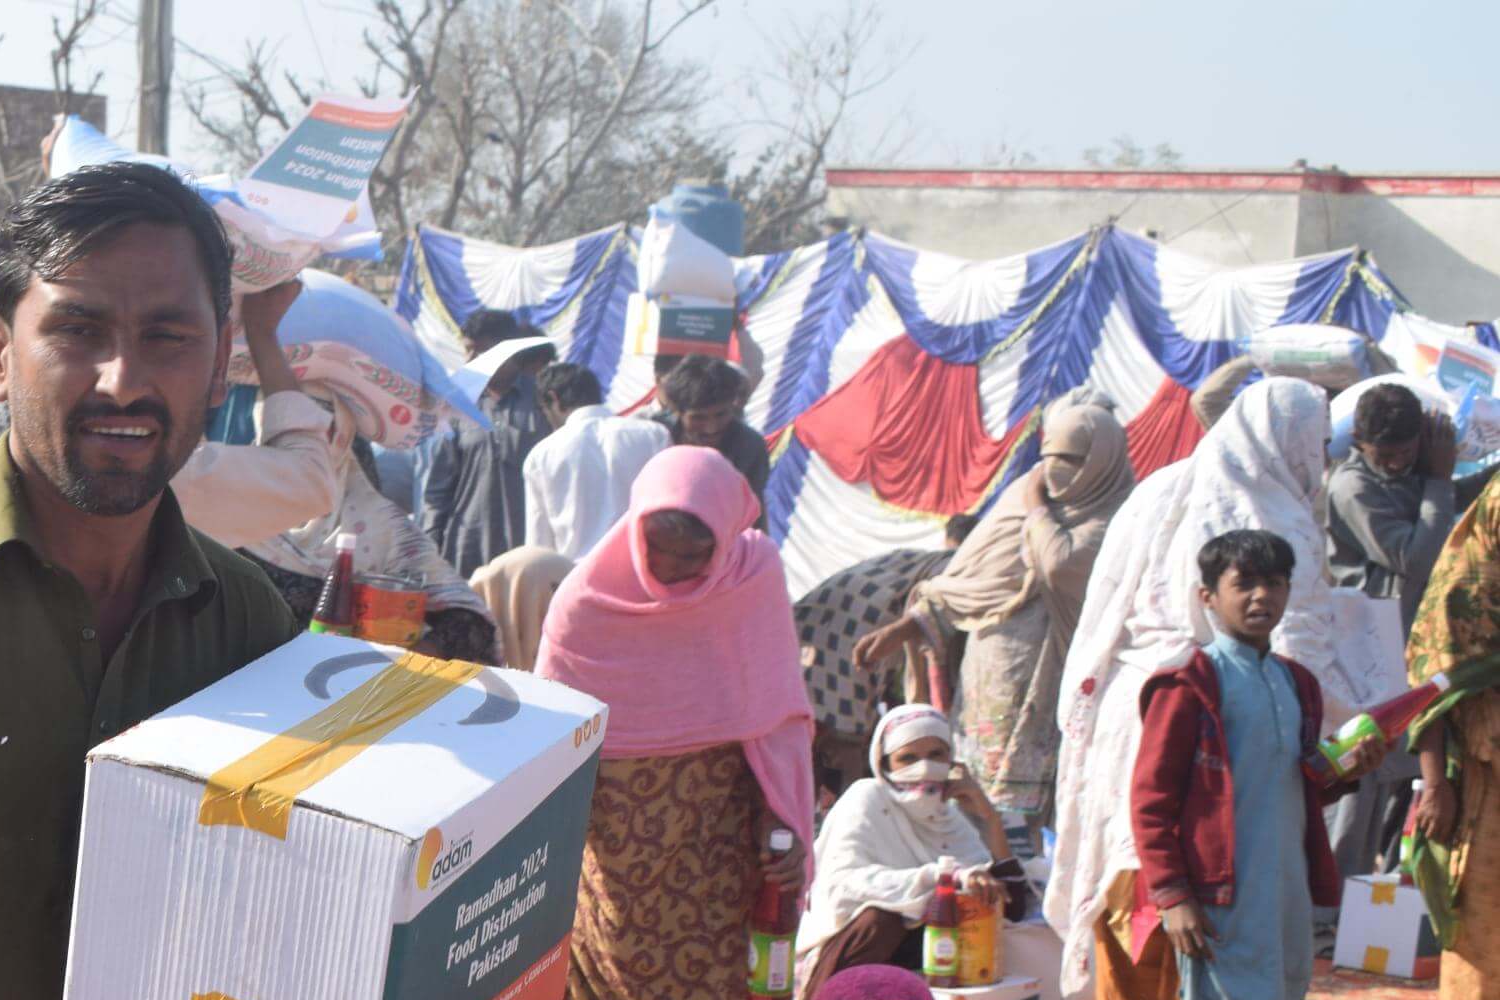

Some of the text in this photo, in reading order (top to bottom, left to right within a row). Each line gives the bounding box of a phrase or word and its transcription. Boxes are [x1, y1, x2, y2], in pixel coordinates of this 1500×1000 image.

[283, 159, 325, 180] 2024
[431, 839, 473, 881] adam
[454, 841, 549, 932] Ramadhan 2024
[446, 926, 480, 971] Food
[479, 881, 547, 947] Distribution
[467, 933, 520, 987] Pakistan
